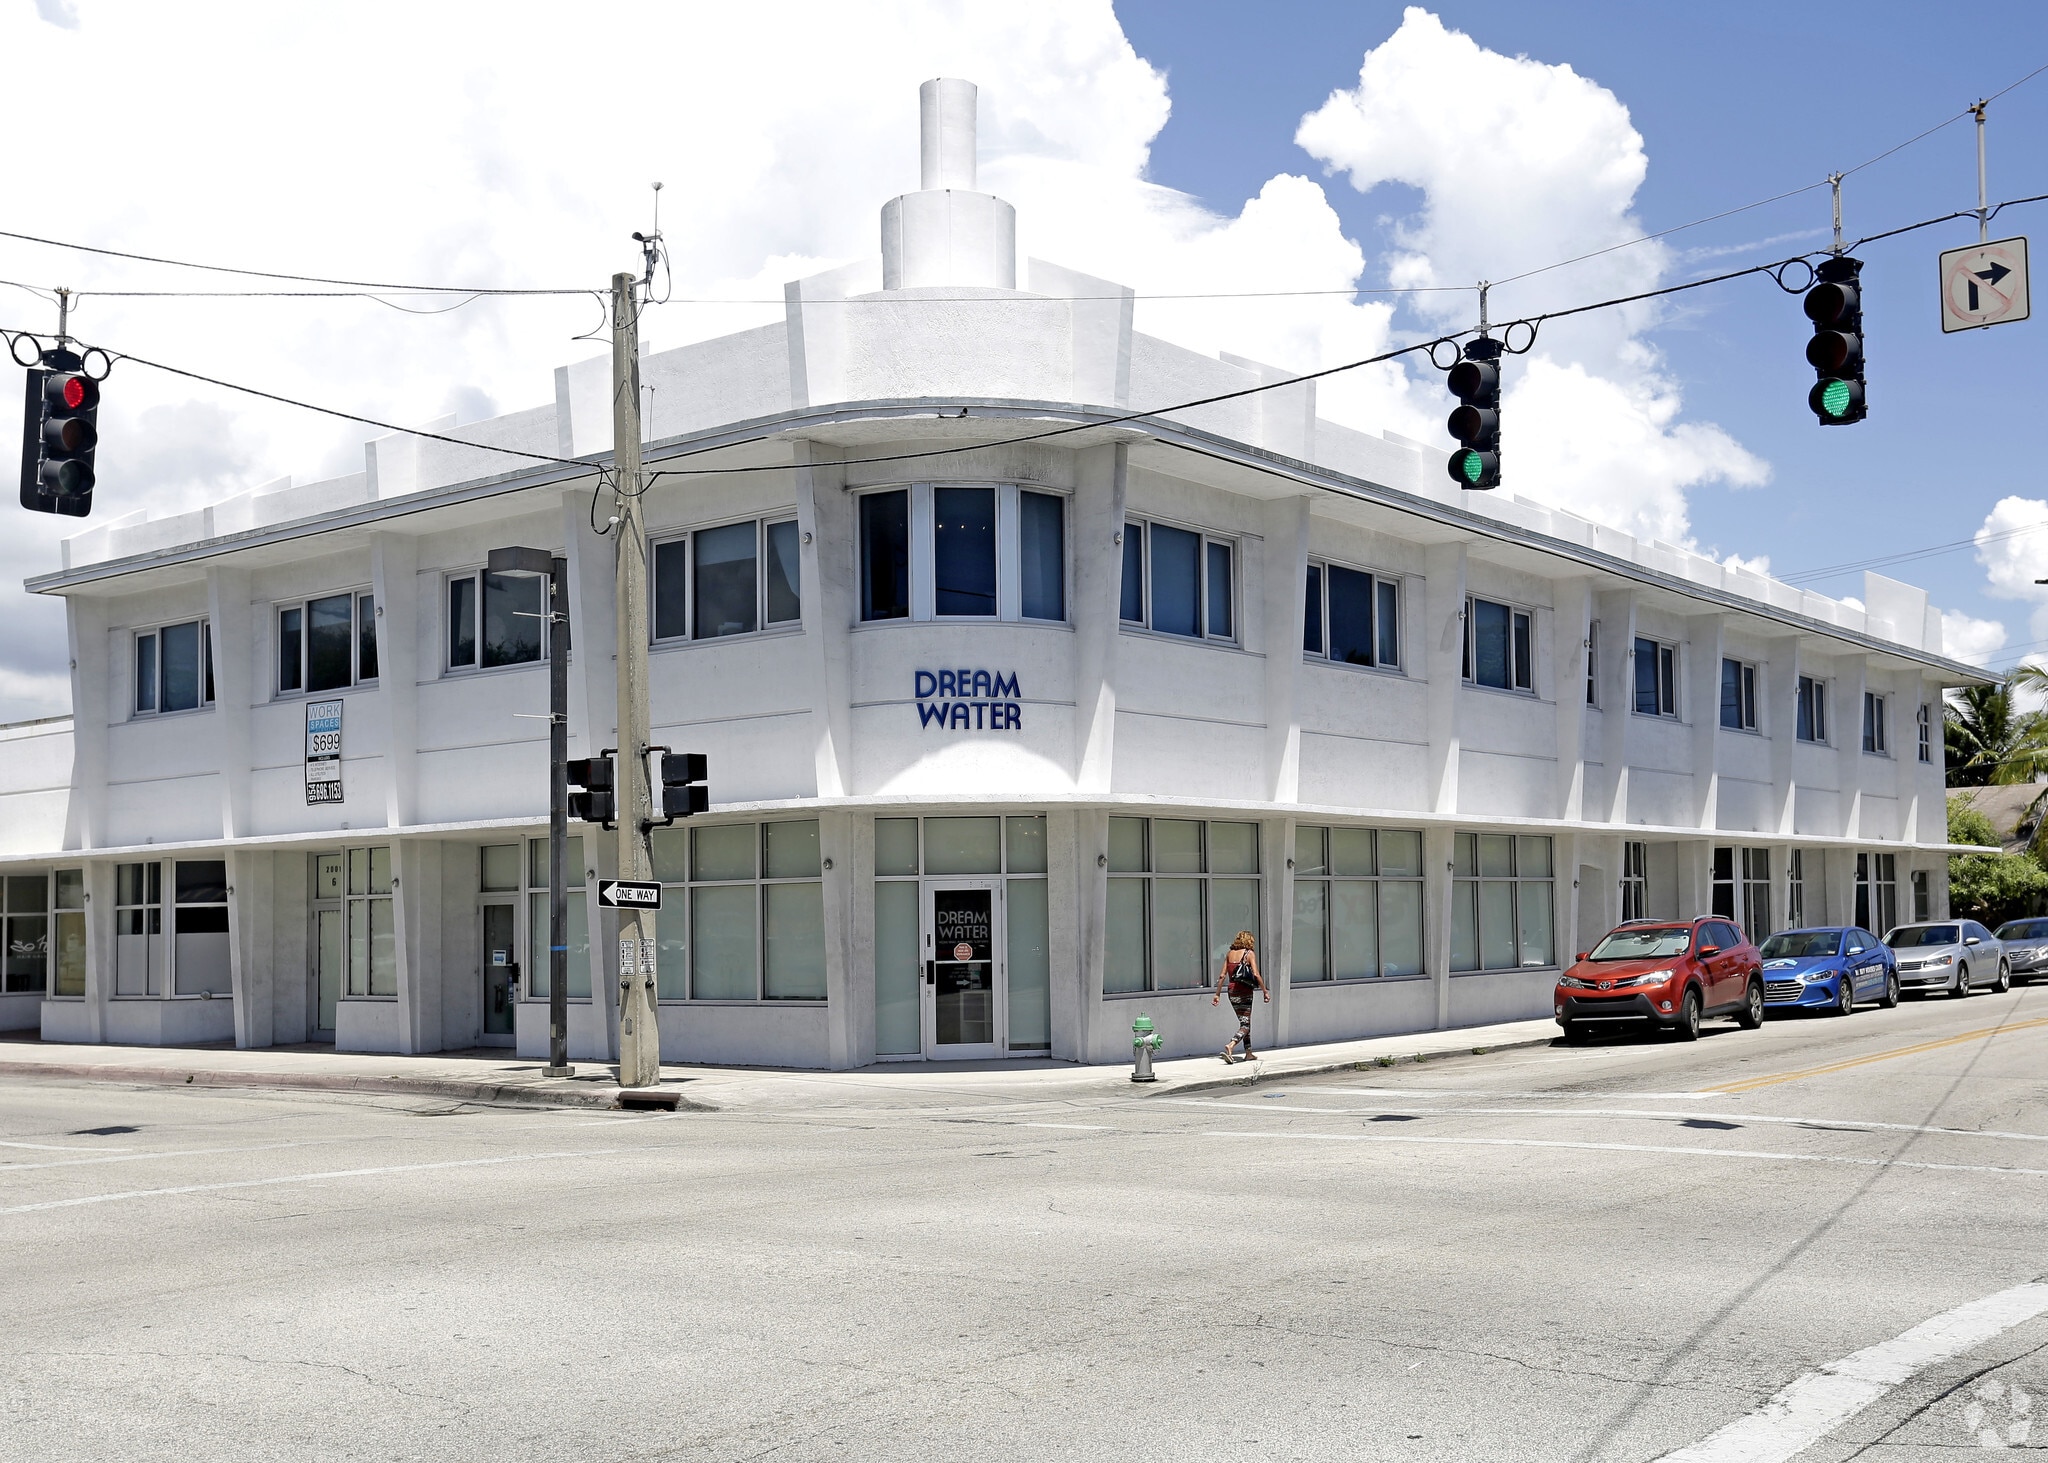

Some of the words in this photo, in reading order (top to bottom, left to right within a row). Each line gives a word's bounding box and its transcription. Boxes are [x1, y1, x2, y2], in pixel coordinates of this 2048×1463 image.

[915, 669, 1021, 698] DREAM
[309, 704, 340, 719] WORK
[916, 702, 1021, 730] WATER
[310, 718, 339, 729] SPACES
[313, 733, 340, 752] $699
[308, 783, 316, 801] 954
[332, 877, 337, 886] 6
[615, 888, 633, 900] ONE
[636, 890, 655, 901] WAY
[938, 911, 988, 924] DREAM
[939, 925, 988, 939] WATER
